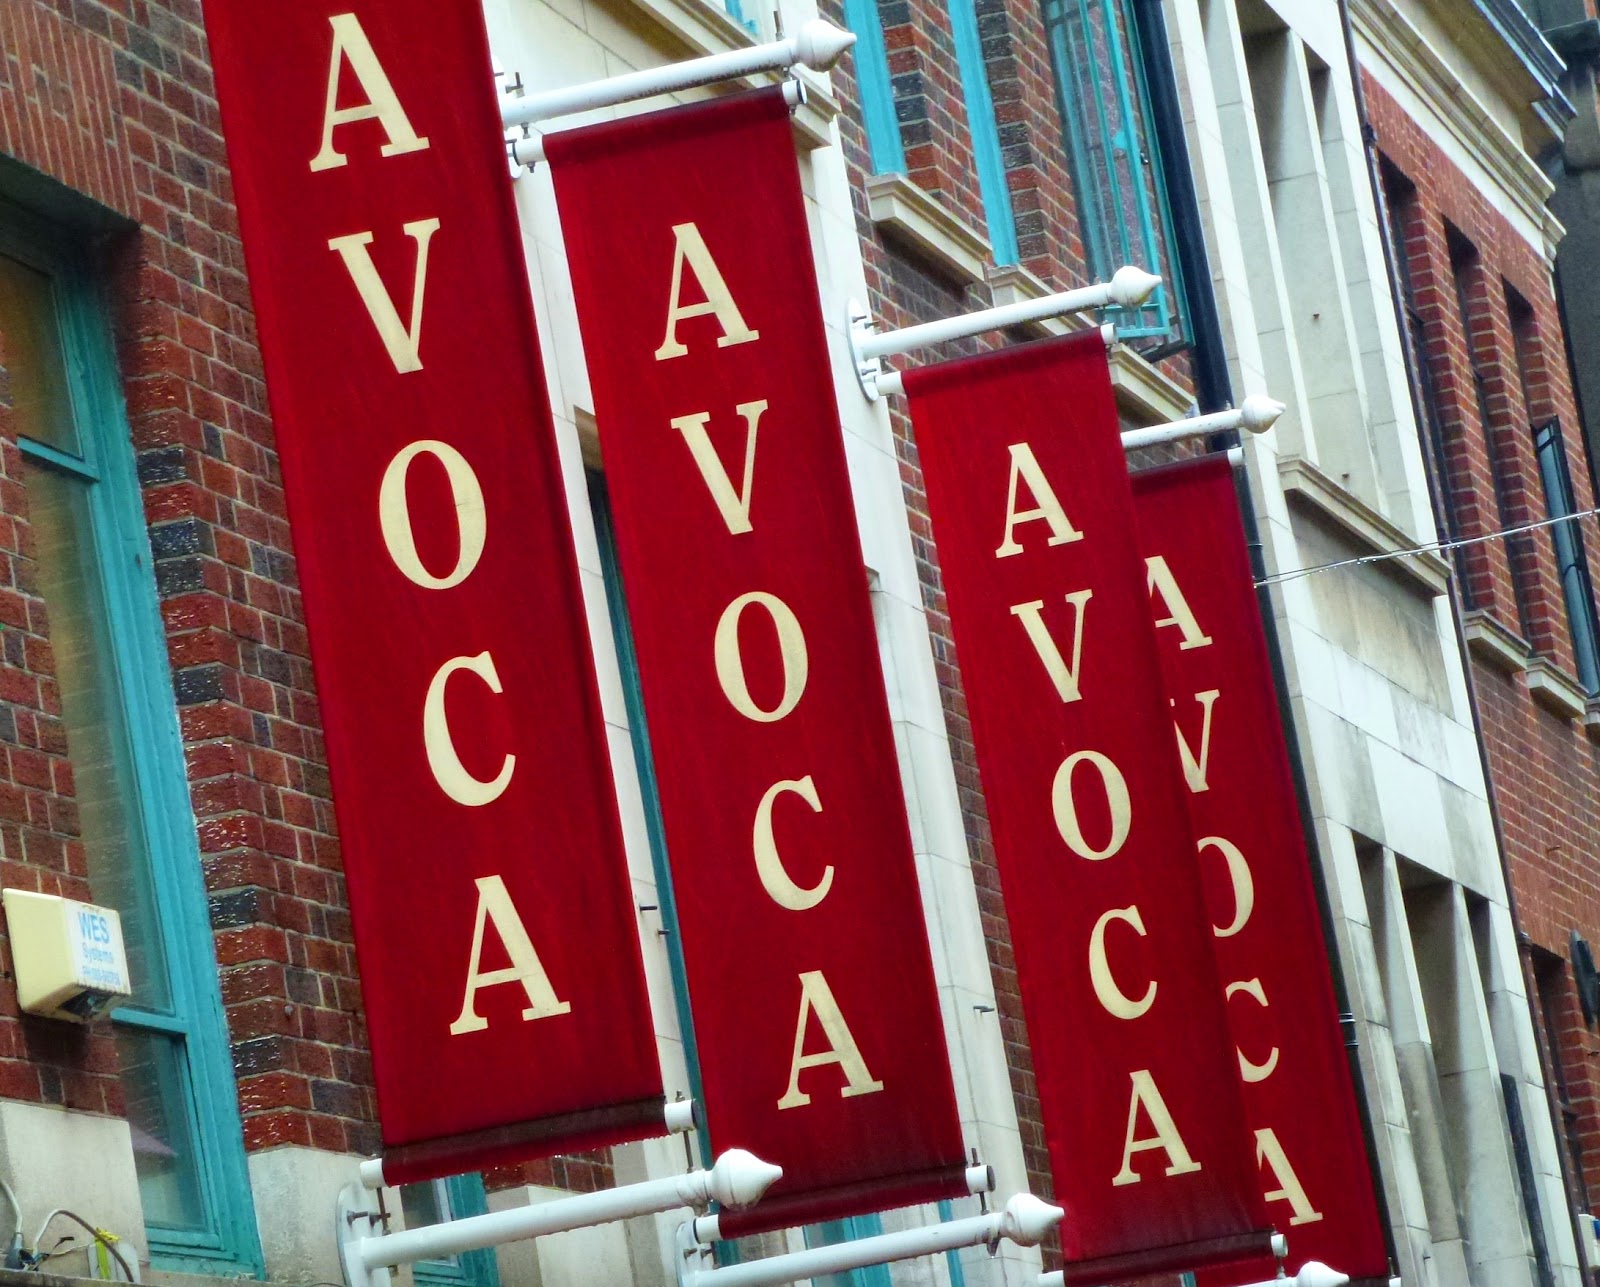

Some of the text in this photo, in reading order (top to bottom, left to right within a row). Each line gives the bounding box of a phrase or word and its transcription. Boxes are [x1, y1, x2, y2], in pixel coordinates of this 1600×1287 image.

[78, 911, 110, 944] WES
[309, 12, 572, 1036] AVOCA
[654, 221, 884, 1110] AVOCA
[995, 442, 1202, 1187] AVOCA
